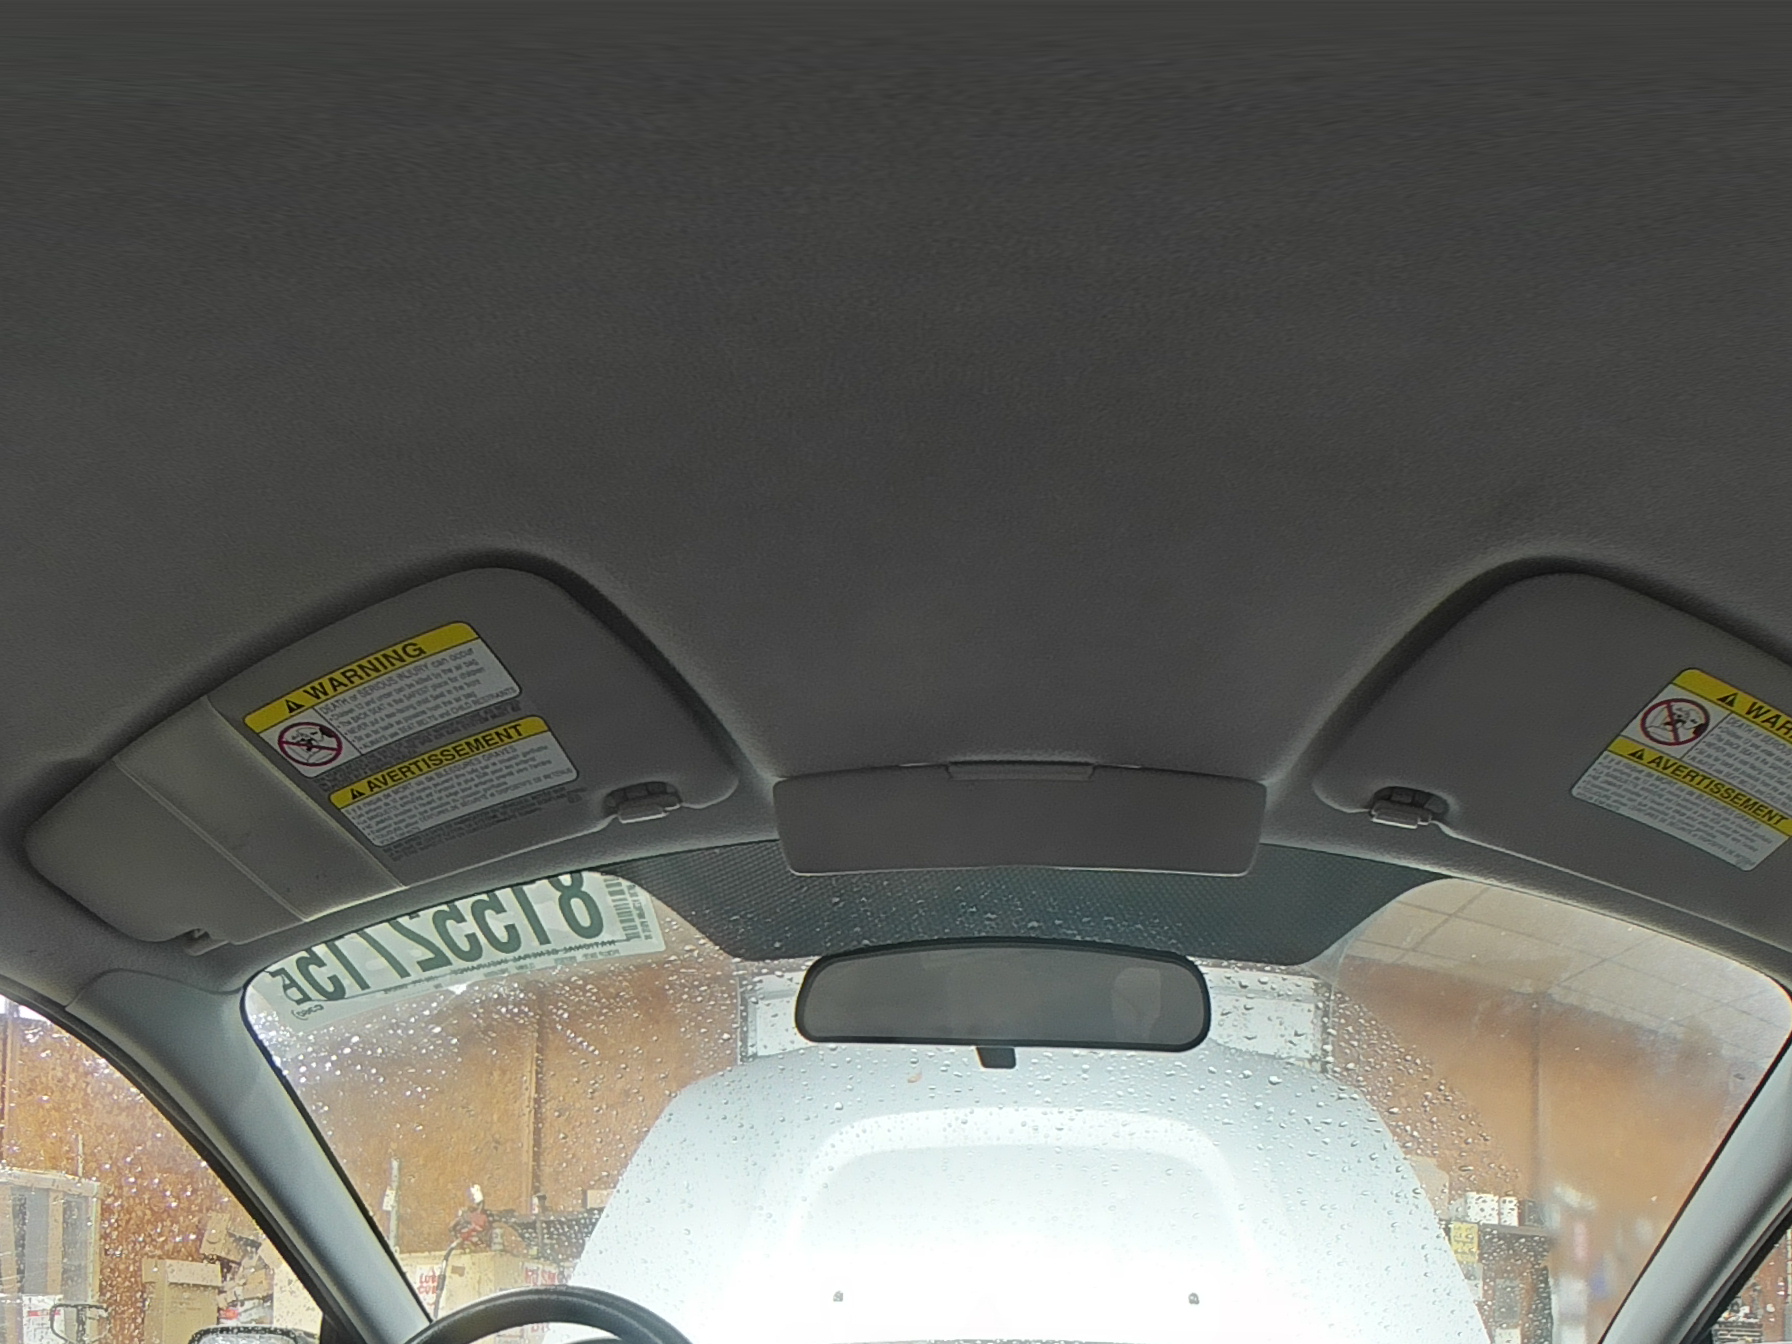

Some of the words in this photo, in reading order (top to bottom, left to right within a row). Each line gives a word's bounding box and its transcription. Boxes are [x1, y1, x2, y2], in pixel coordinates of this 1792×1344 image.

[305, 641, 427, 703] WARNING
[366, 723, 524, 794] AVERTISSEMENT
[1647, 754, 1789, 827] AVERTISSEMENT
